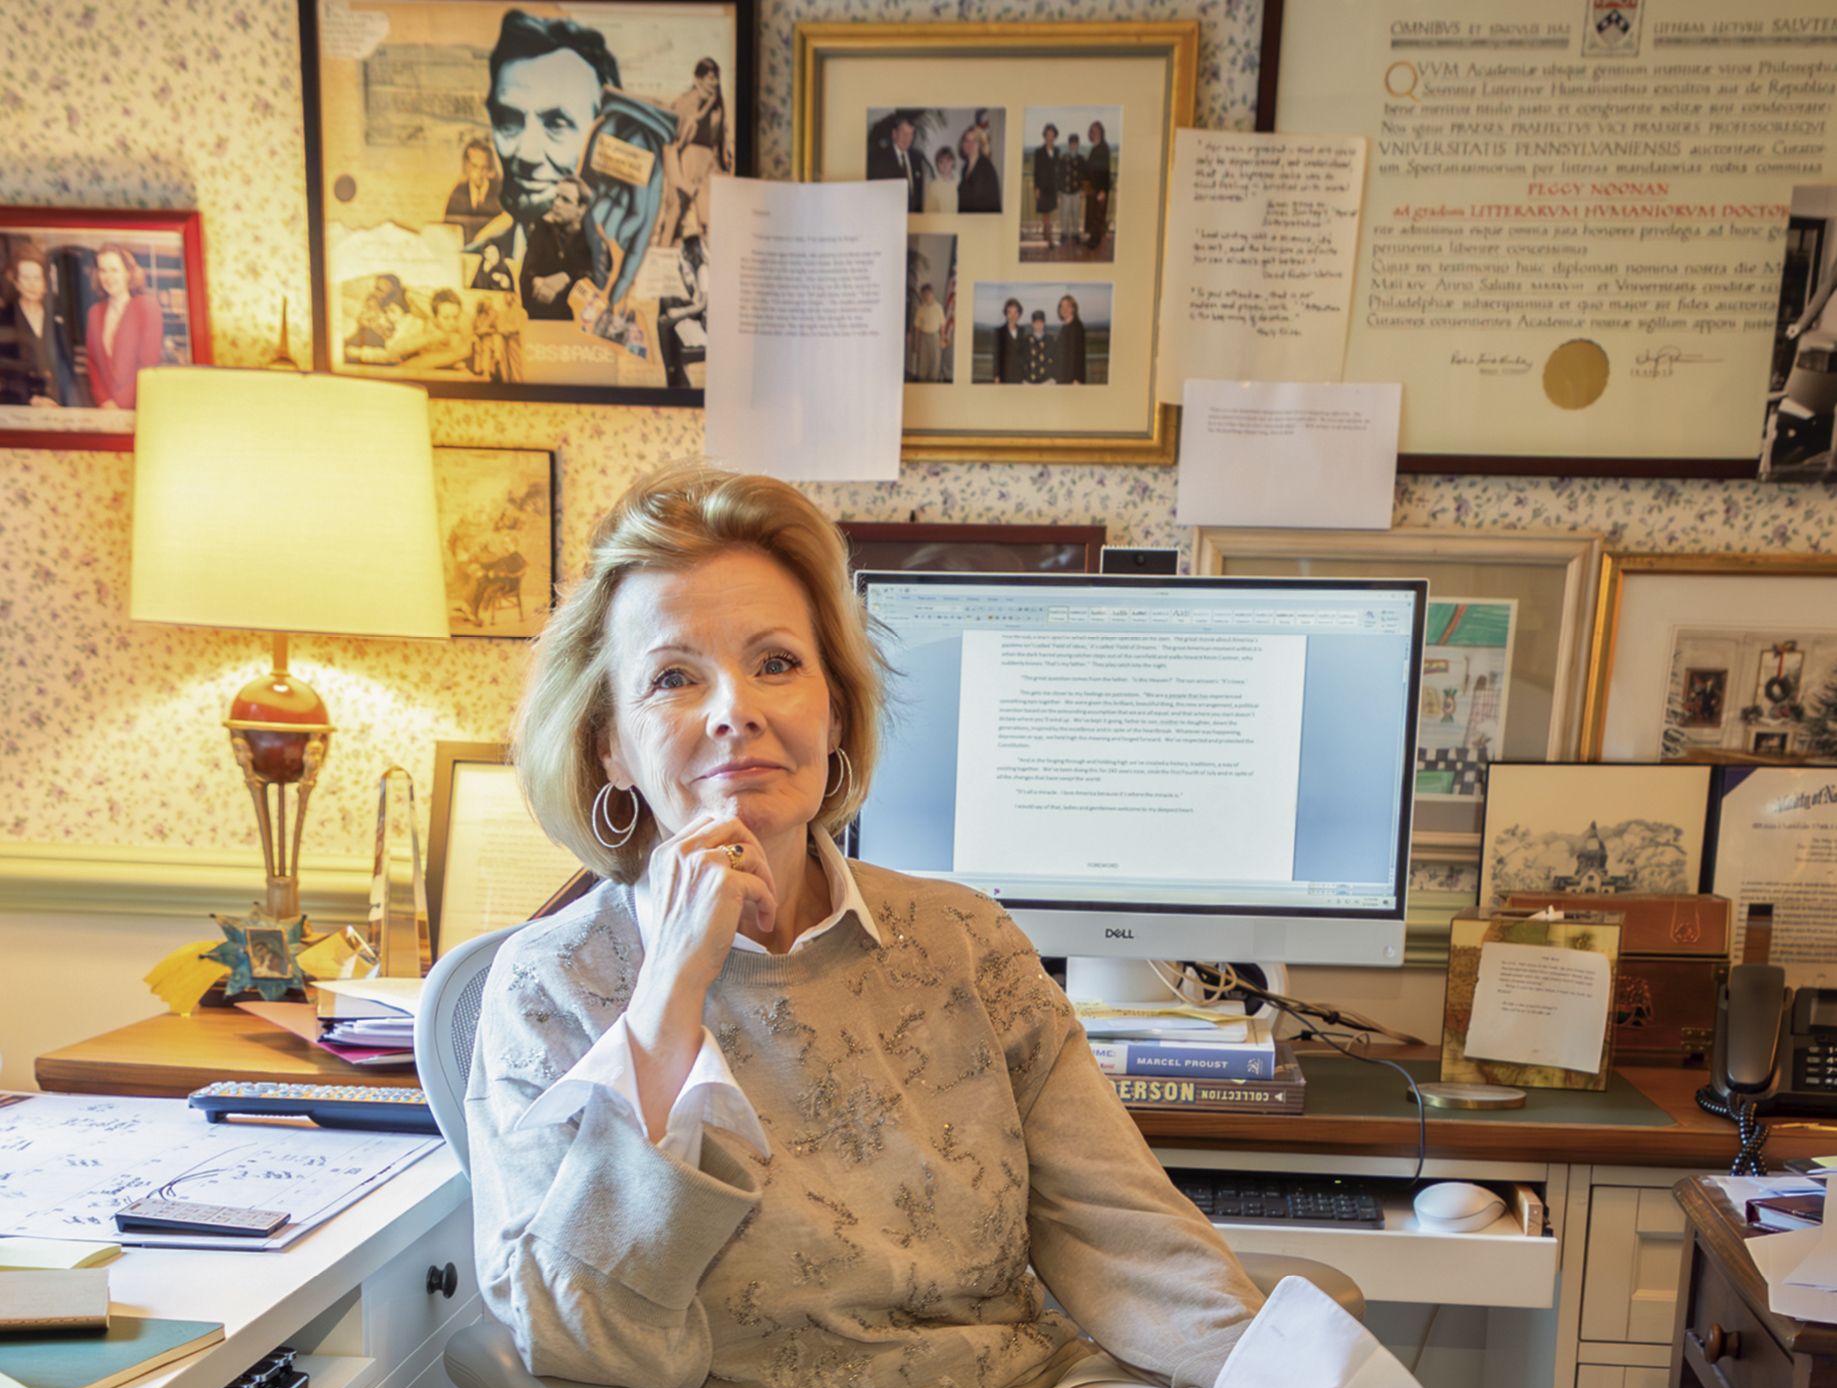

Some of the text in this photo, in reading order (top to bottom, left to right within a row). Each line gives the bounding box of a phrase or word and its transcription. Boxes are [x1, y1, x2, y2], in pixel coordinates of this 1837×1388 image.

[1527, 182, 1669, 196] PEGGY NOONAN
[1470, 204, 1579, 218] LITTERARVM
[1585, 203, 1716, 218] HVMANIORVM
[1105, 928, 1135, 939] DELL
[1136, 1057, 1229, 1070] MARCEL PROUST
[1118, 1080, 1196, 1102] ERSON
[1201, 1089, 1270, 1102] COLLECTION
